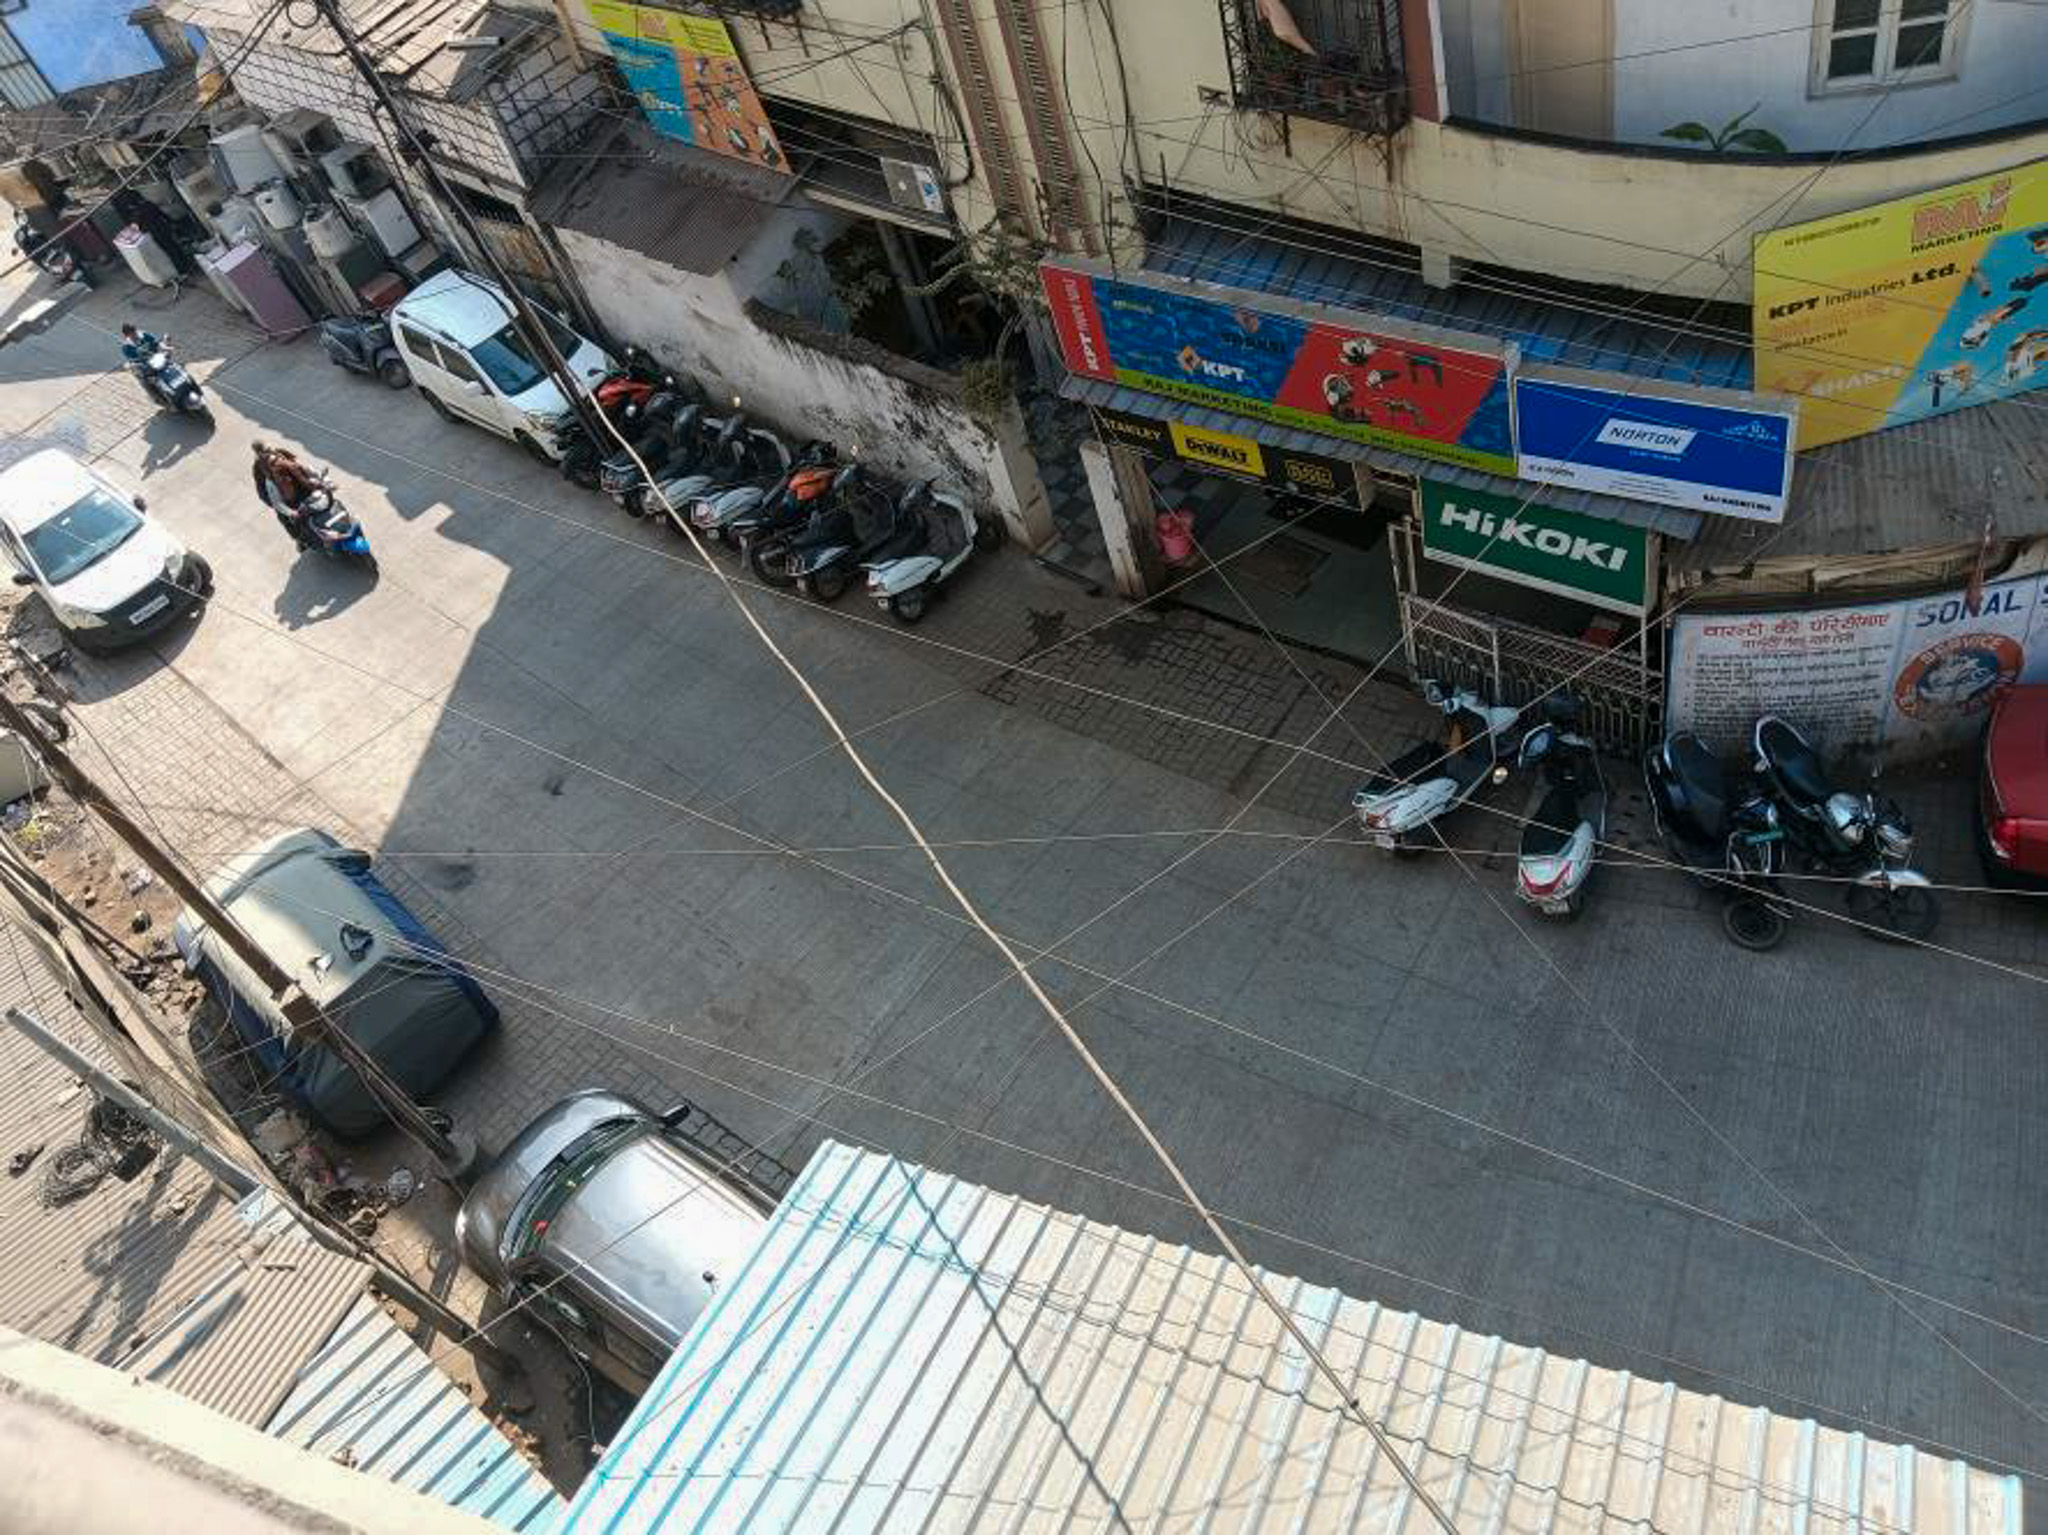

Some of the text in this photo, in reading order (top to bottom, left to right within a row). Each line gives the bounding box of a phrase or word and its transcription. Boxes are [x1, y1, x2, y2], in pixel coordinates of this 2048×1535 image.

[1911, 223, 2003, 253] MARKETING
[1768, 296, 1820, 320] KPT
[1825, 278, 1906, 307] Industries
[1910, 262, 1961, 286] Ltd.
[1202, 359, 1245, 382] KPT
[1610, 427, 1681, 446] NORTON
